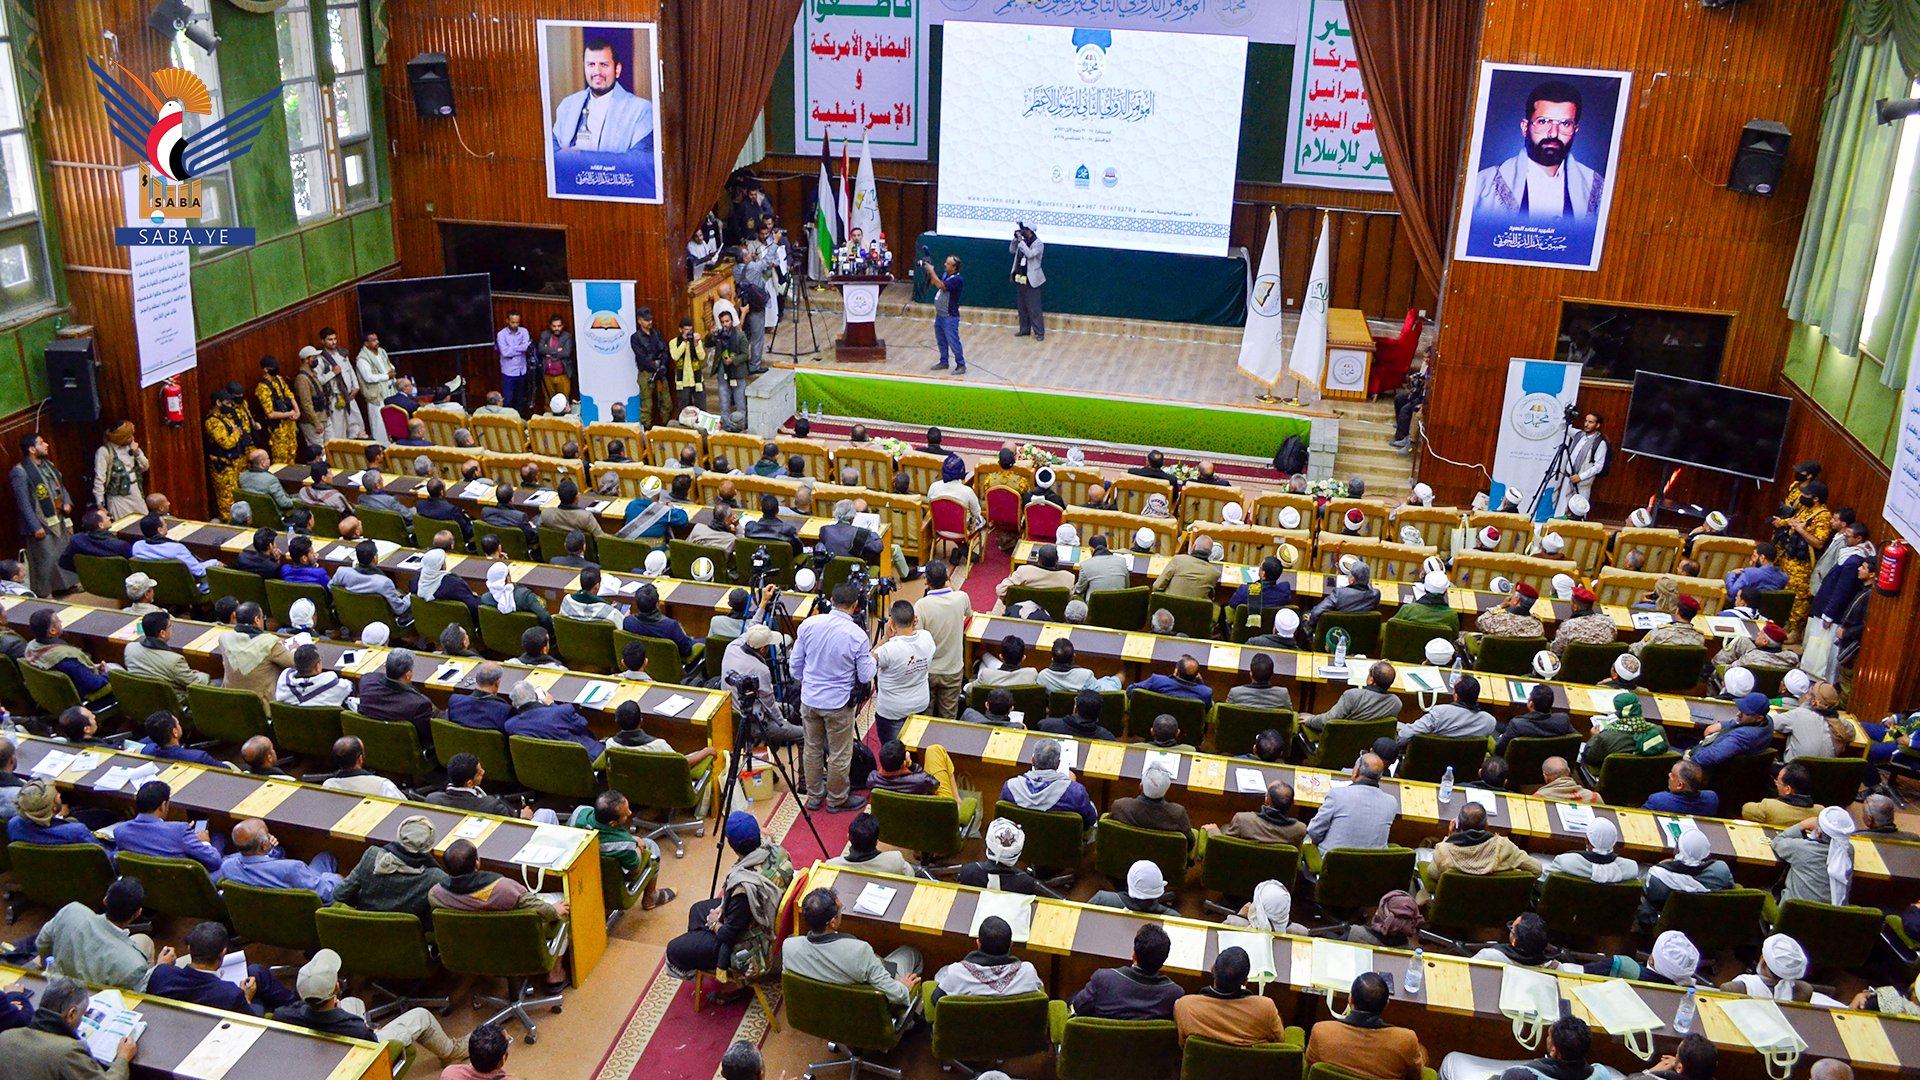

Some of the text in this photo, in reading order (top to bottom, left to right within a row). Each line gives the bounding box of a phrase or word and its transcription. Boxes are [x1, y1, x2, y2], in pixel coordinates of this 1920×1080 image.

[811, 29, 911, 63] البضائع الأمريكية
[855, 68, 863, 91] و
[812, 99, 911, 131] الإسرائيلية
[1305, 111, 1348, 133] اليهود
[1302, 137, 1360, 172] للإسلام
